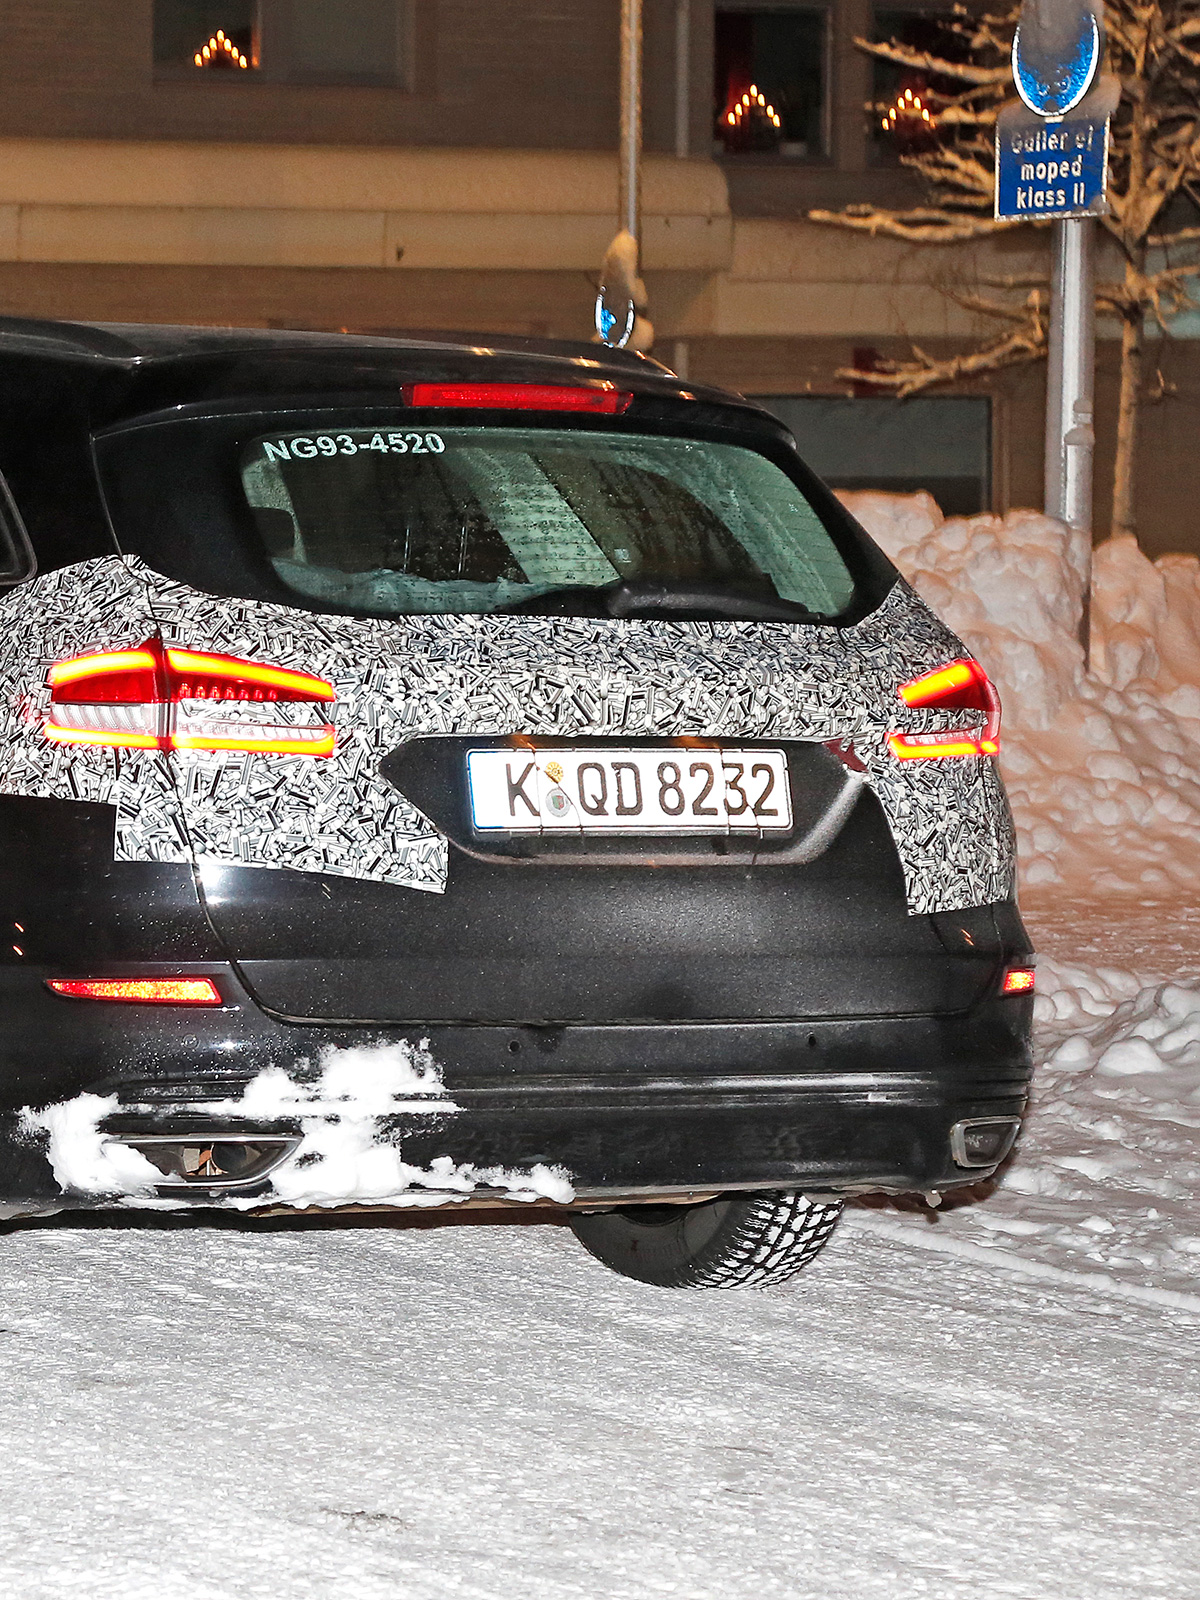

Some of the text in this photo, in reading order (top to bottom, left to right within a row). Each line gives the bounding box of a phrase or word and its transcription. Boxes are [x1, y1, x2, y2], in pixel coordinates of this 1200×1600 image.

[1021, 154, 1083, 184] moped
[1017, 186, 1066, 209] klass
[262, 432, 446, 462] NG93-4520
[505, 761, 779, 817] K QD 8232
